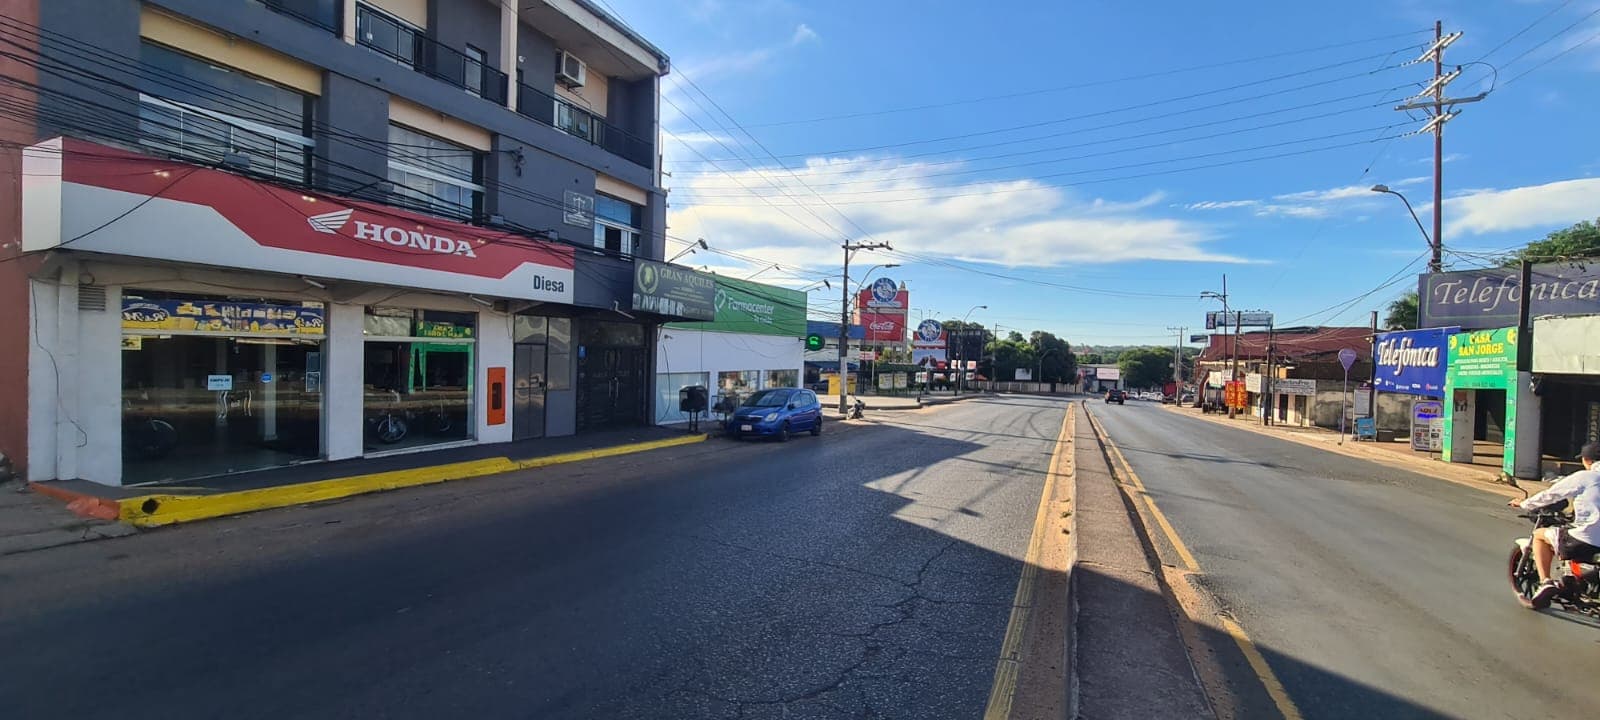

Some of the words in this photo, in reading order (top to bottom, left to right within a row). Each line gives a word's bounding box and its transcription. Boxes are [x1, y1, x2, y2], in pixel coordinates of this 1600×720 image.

[354, 220, 477, 258] HONDA
[533, 275, 564, 293] Diesa
[660, 268, 682, 282] GRAN
[684, 274, 714, 289] AQUILES
[728, 297, 775, 315] Farmacenter
[1469, 332, 1492, 345] CASA
[1458, 345, 1475, 357] SAN
[1475, 342, 1504, 355] JORGE
